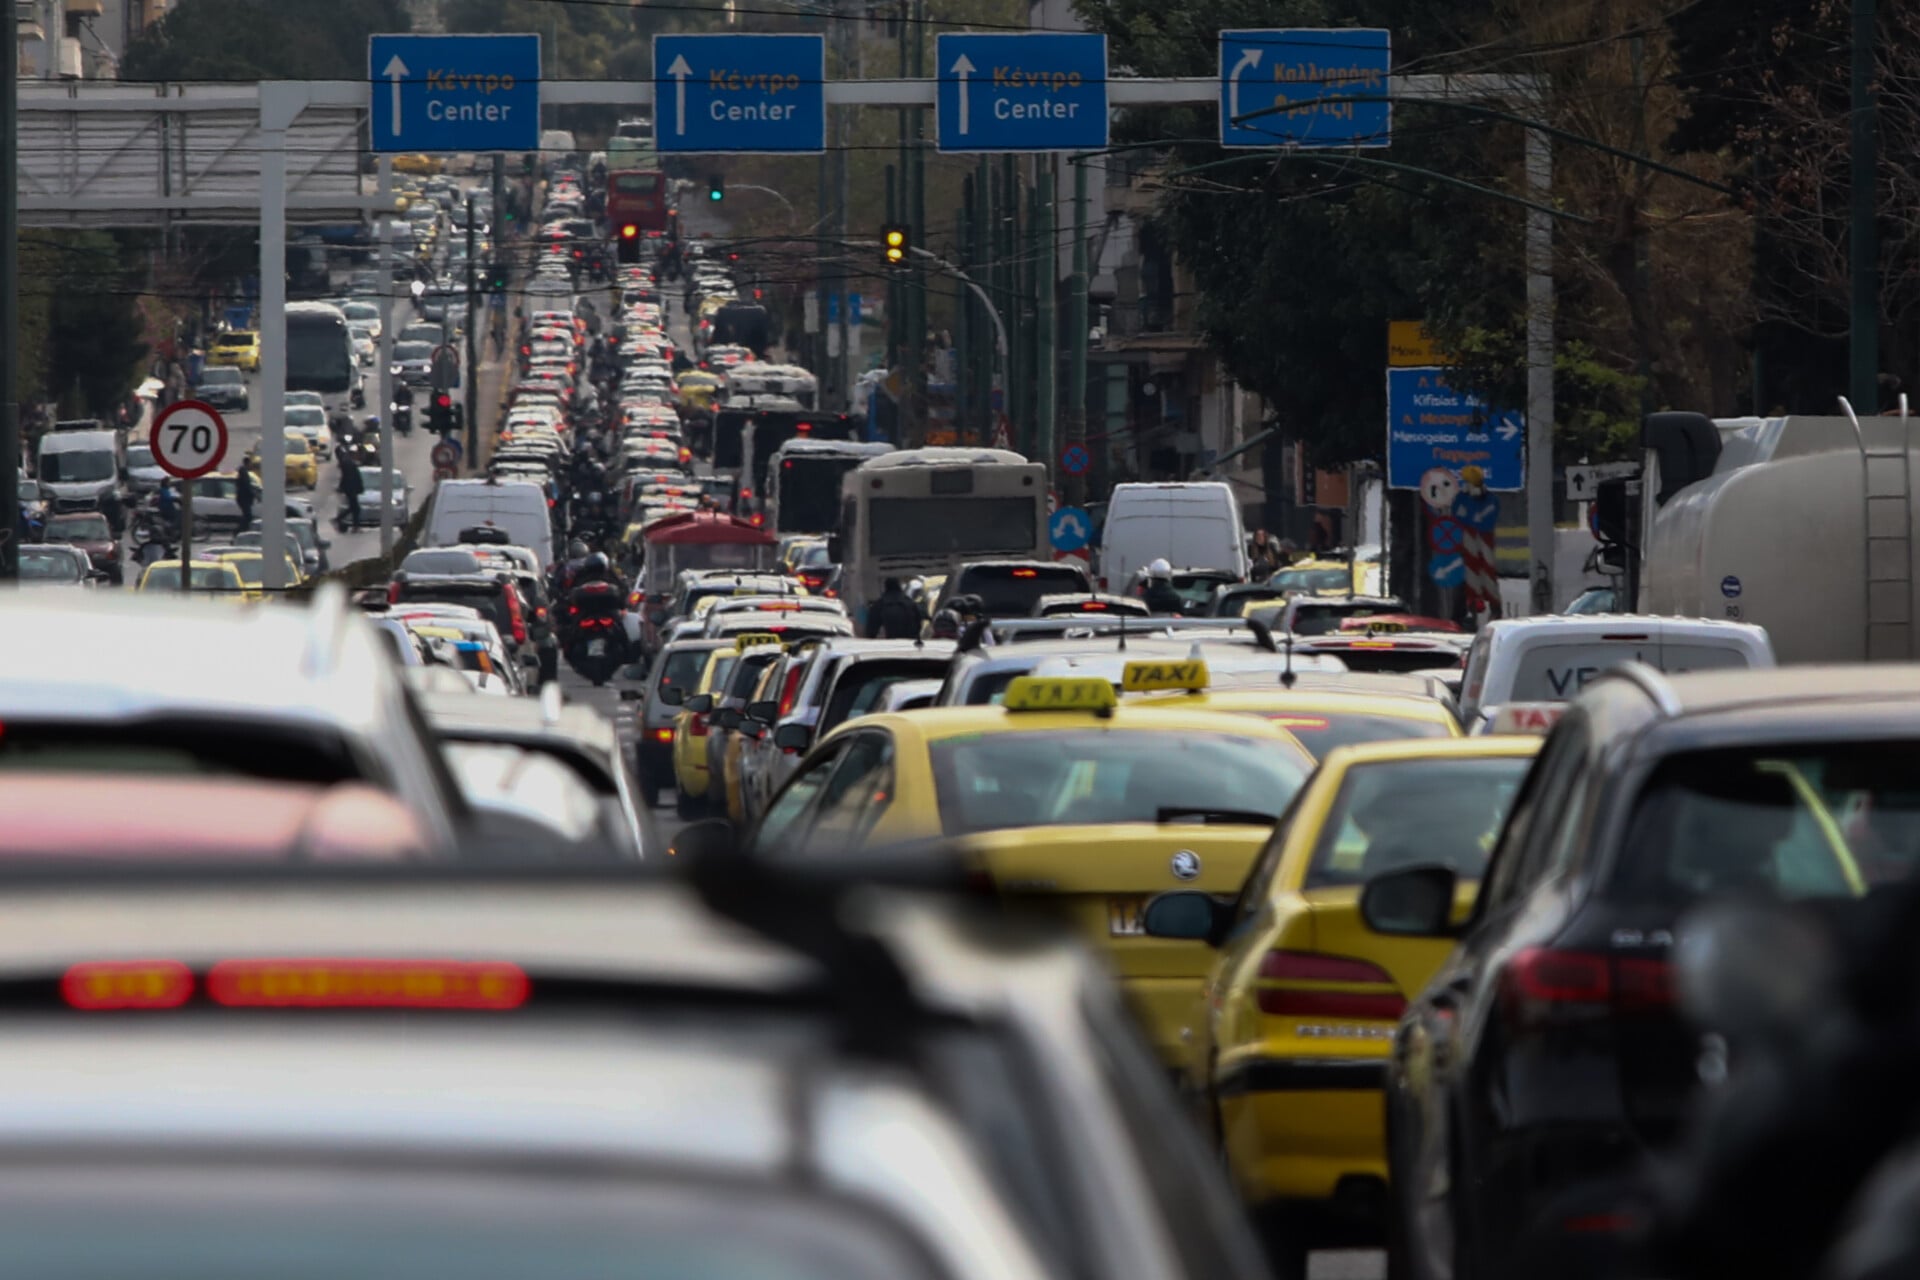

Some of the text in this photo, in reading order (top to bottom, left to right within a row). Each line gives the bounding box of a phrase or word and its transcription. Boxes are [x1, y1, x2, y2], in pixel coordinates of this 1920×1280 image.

[425, 68, 515, 95] Κέντρο
[708, 68, 800, 95] Κέντρο
[992, 66, 1082, 93] Κέντρο
[426, 99, 512, 122] Center
[709, 99, 797, 122] Center
[993, 97, 1080, 119] Center
[168, 425, 211, 454] 70
[1130, 664, 1201, 684] TAXI
